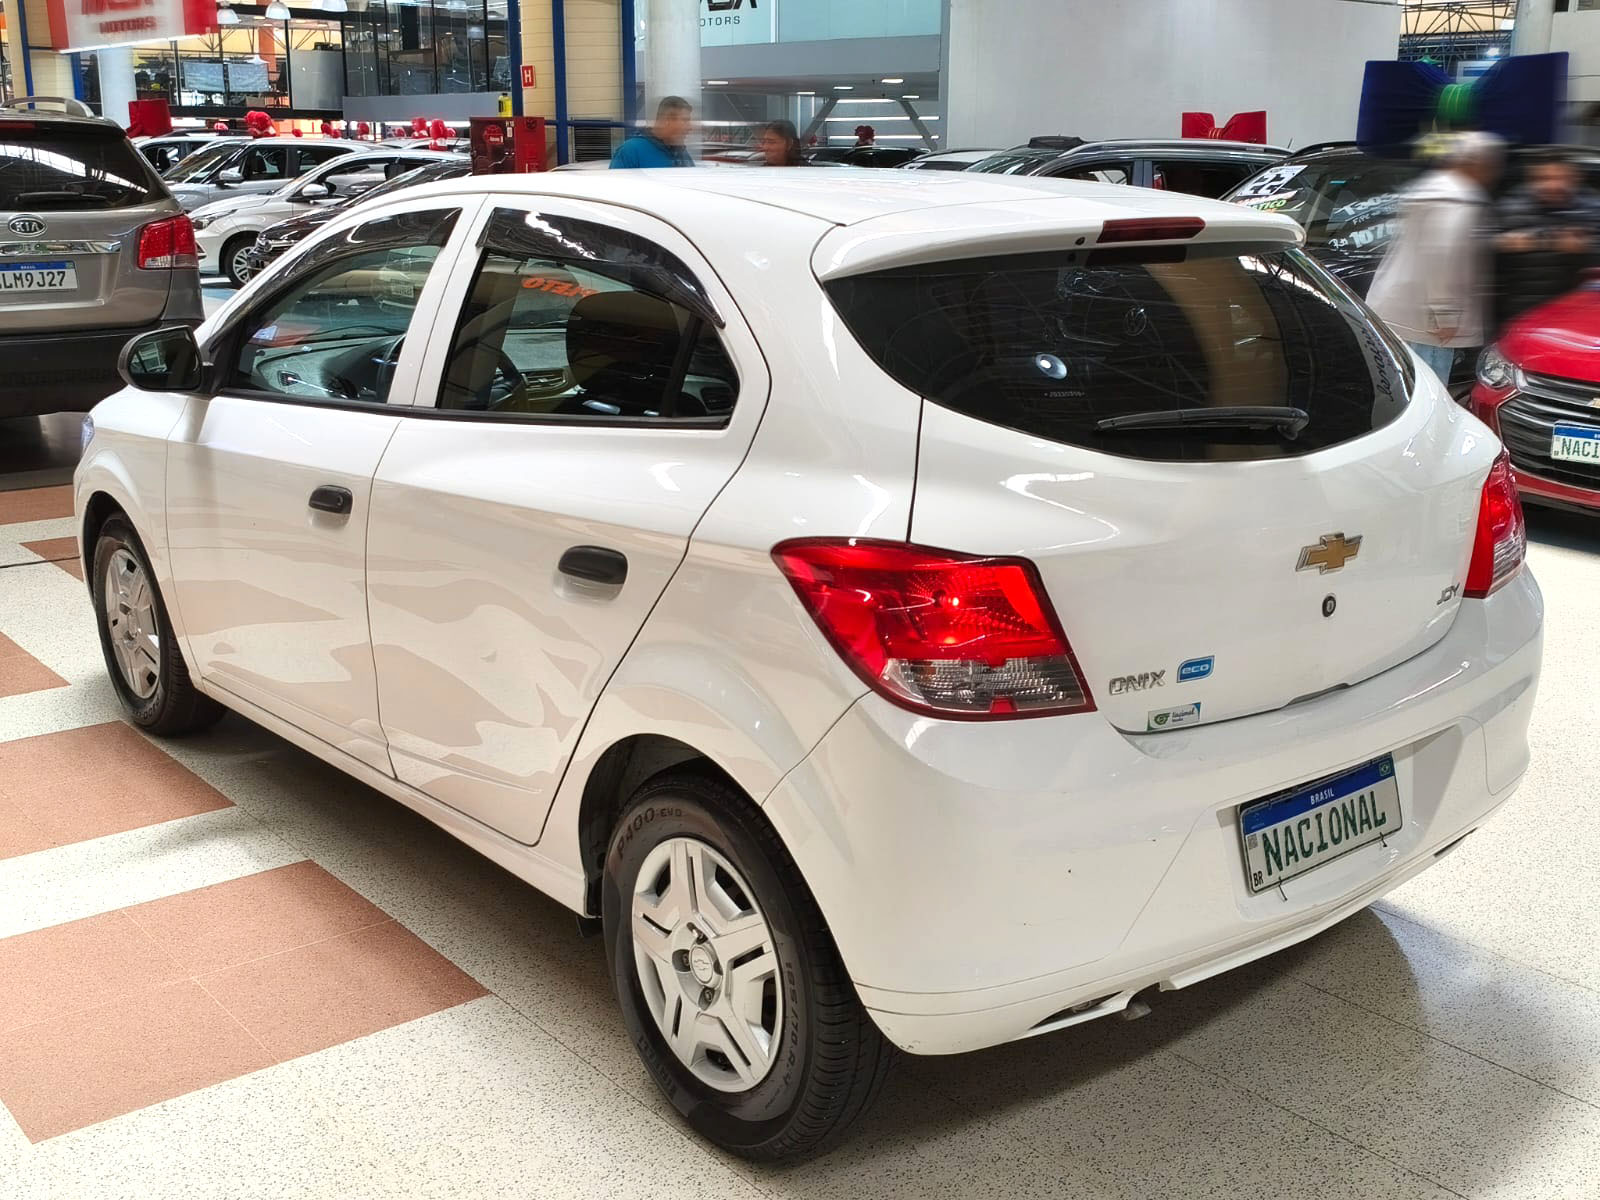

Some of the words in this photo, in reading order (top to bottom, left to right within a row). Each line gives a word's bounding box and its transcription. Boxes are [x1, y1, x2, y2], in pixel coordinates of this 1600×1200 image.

[699, 15, 741, 27] OTORS
[524, 69, 533, 84] H
[14, 221, 40, 233] KIA
[0, 270, 66, 290] LM9J27
[1436, 581, 1461, 606] JOY
[1108, 669, 1166, 696] ONIX
[1181, 663, 1210, 675] eco
[1310, 787, 1335, 806] BRASIL
[1261, 790, 1387, 877] NACIONAL
[1252, 870, 1265, 888] BR
